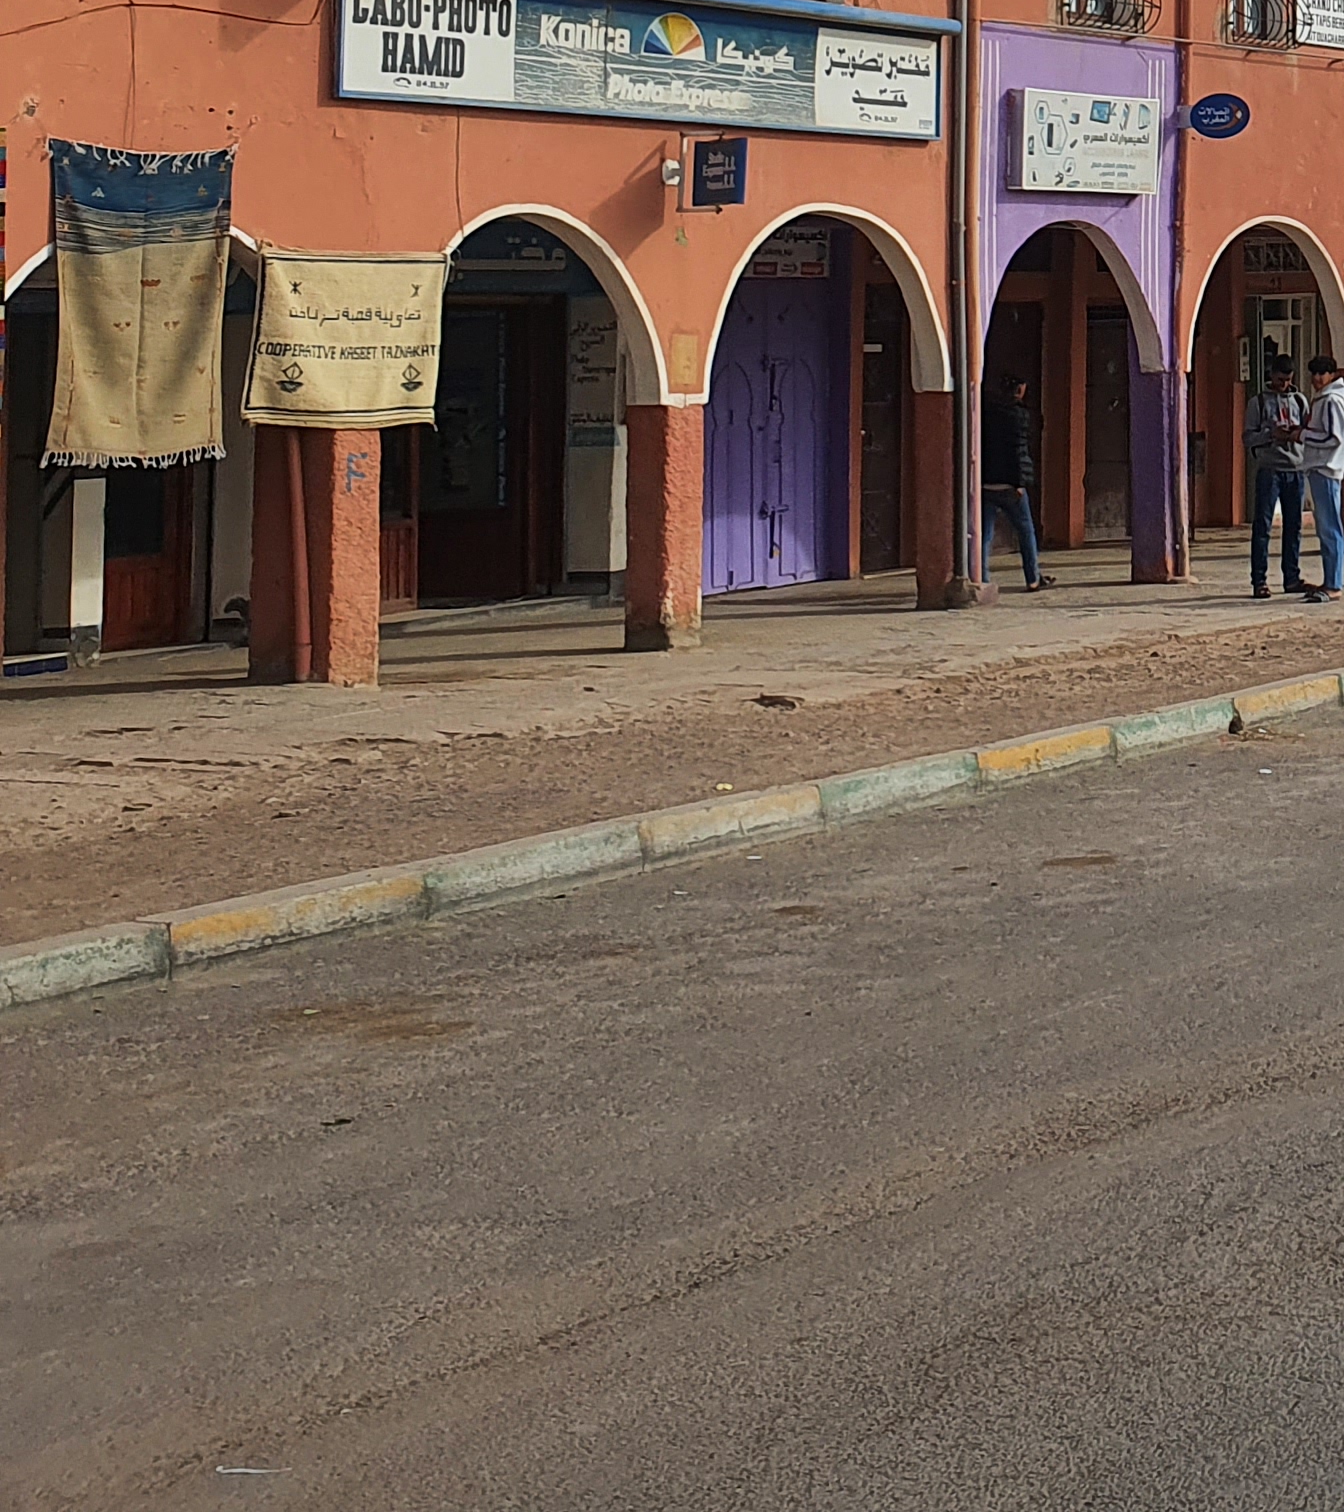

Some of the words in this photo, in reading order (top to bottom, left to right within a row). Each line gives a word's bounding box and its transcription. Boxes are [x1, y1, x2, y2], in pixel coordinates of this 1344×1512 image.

[539, 14, 631, 55] Konica
[381, 31, 466, 79] HAMID
[716, 36, 795, 75] كونيكا
[606, 74, 663, 103] Photo
[669, 79, 751, 111] Express
[256, 341, 337, 360] COOPERATIVE
[380, 344, 437, 359] TAZNAKHT
